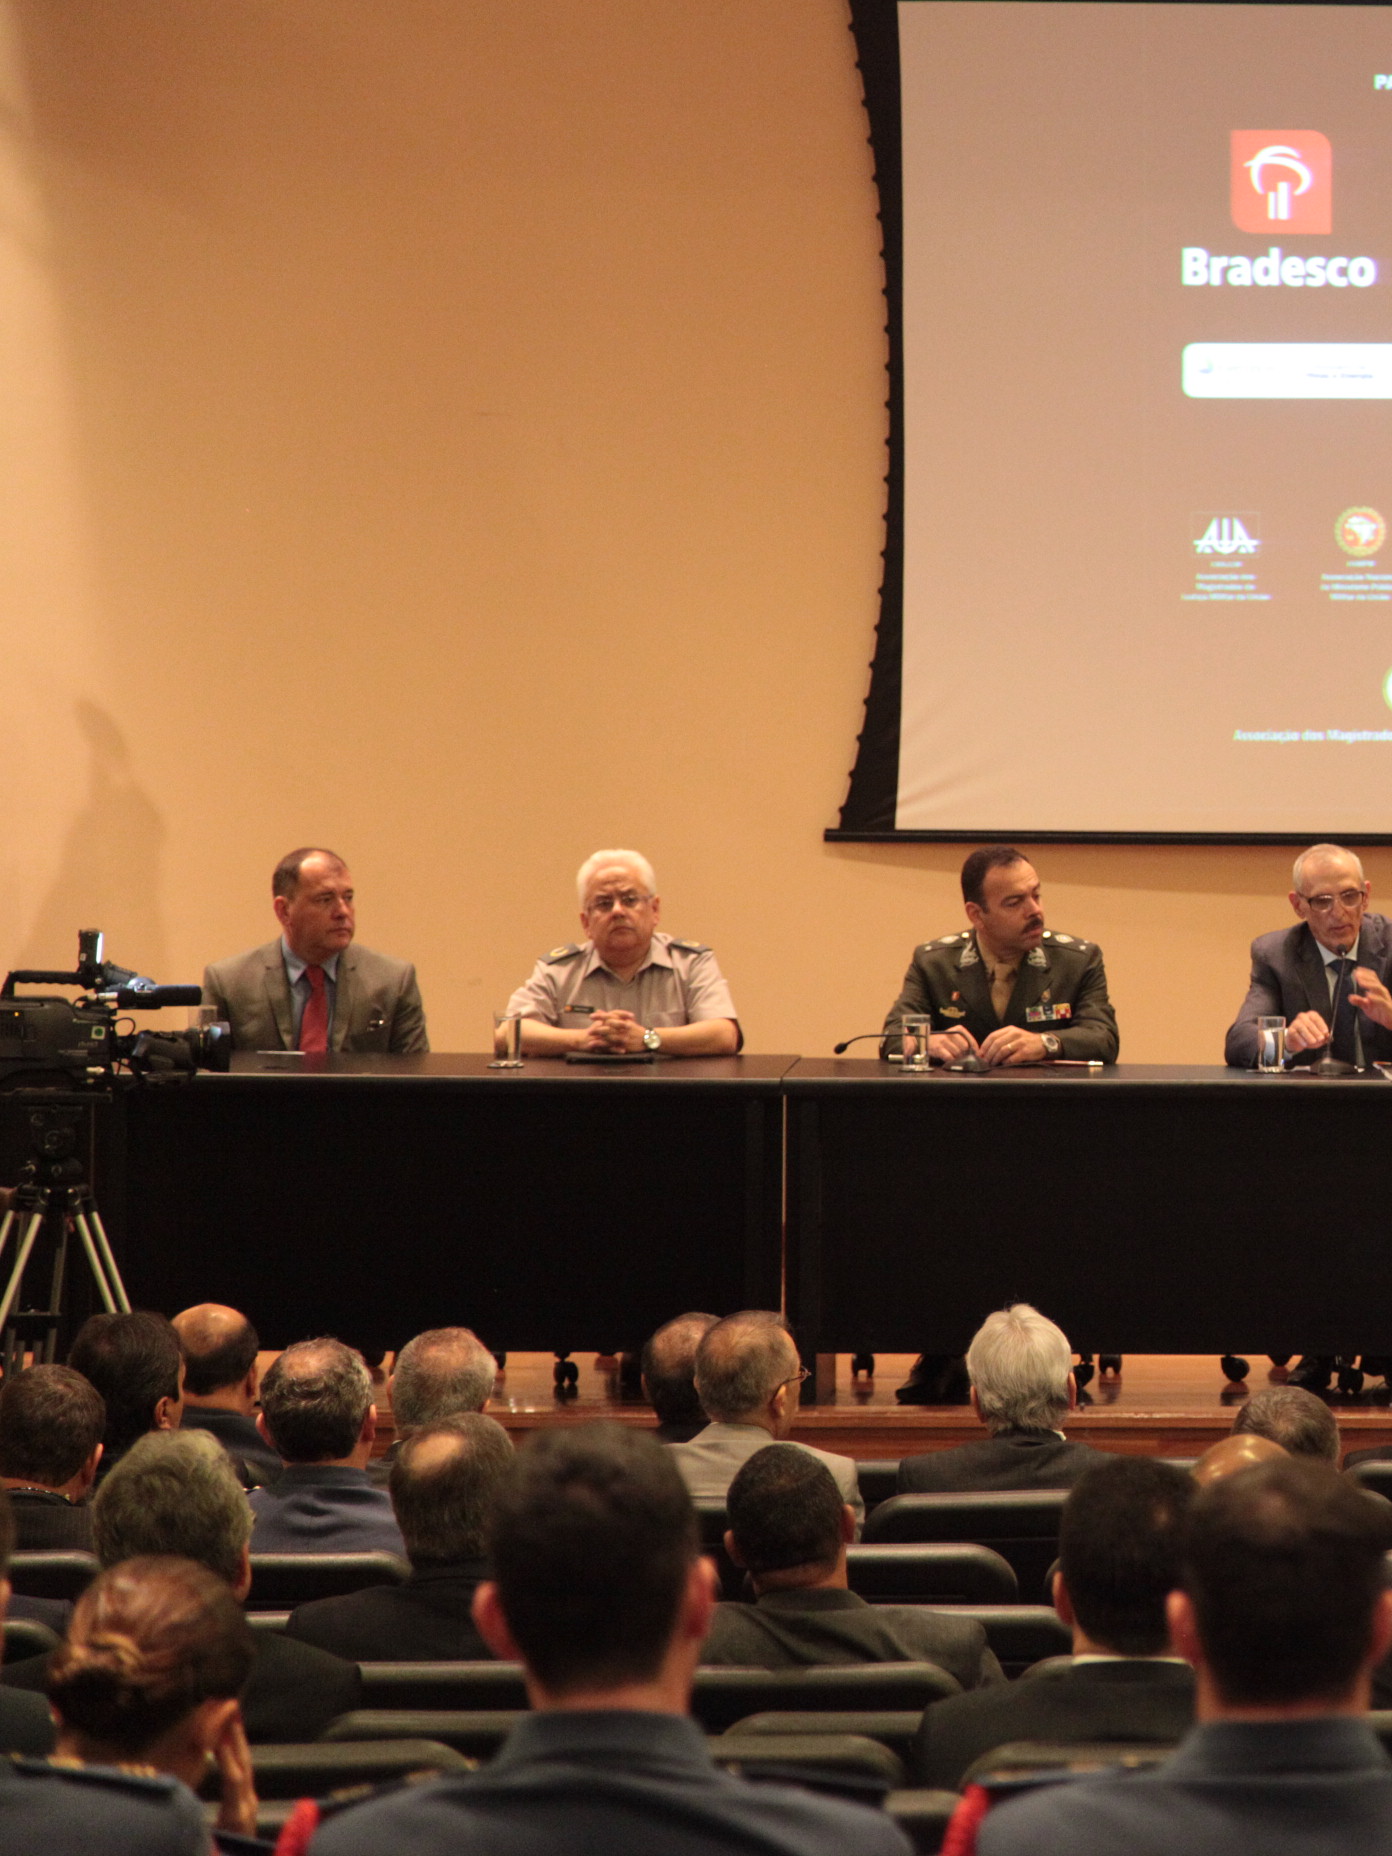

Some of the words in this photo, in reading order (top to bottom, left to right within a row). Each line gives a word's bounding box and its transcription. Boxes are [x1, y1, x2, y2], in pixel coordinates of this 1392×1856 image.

[1181, 246, 1378, 287] Bradesco
[1233, 729, 1300, 743] Associação
[1302, 729, 1325, 741] dos
